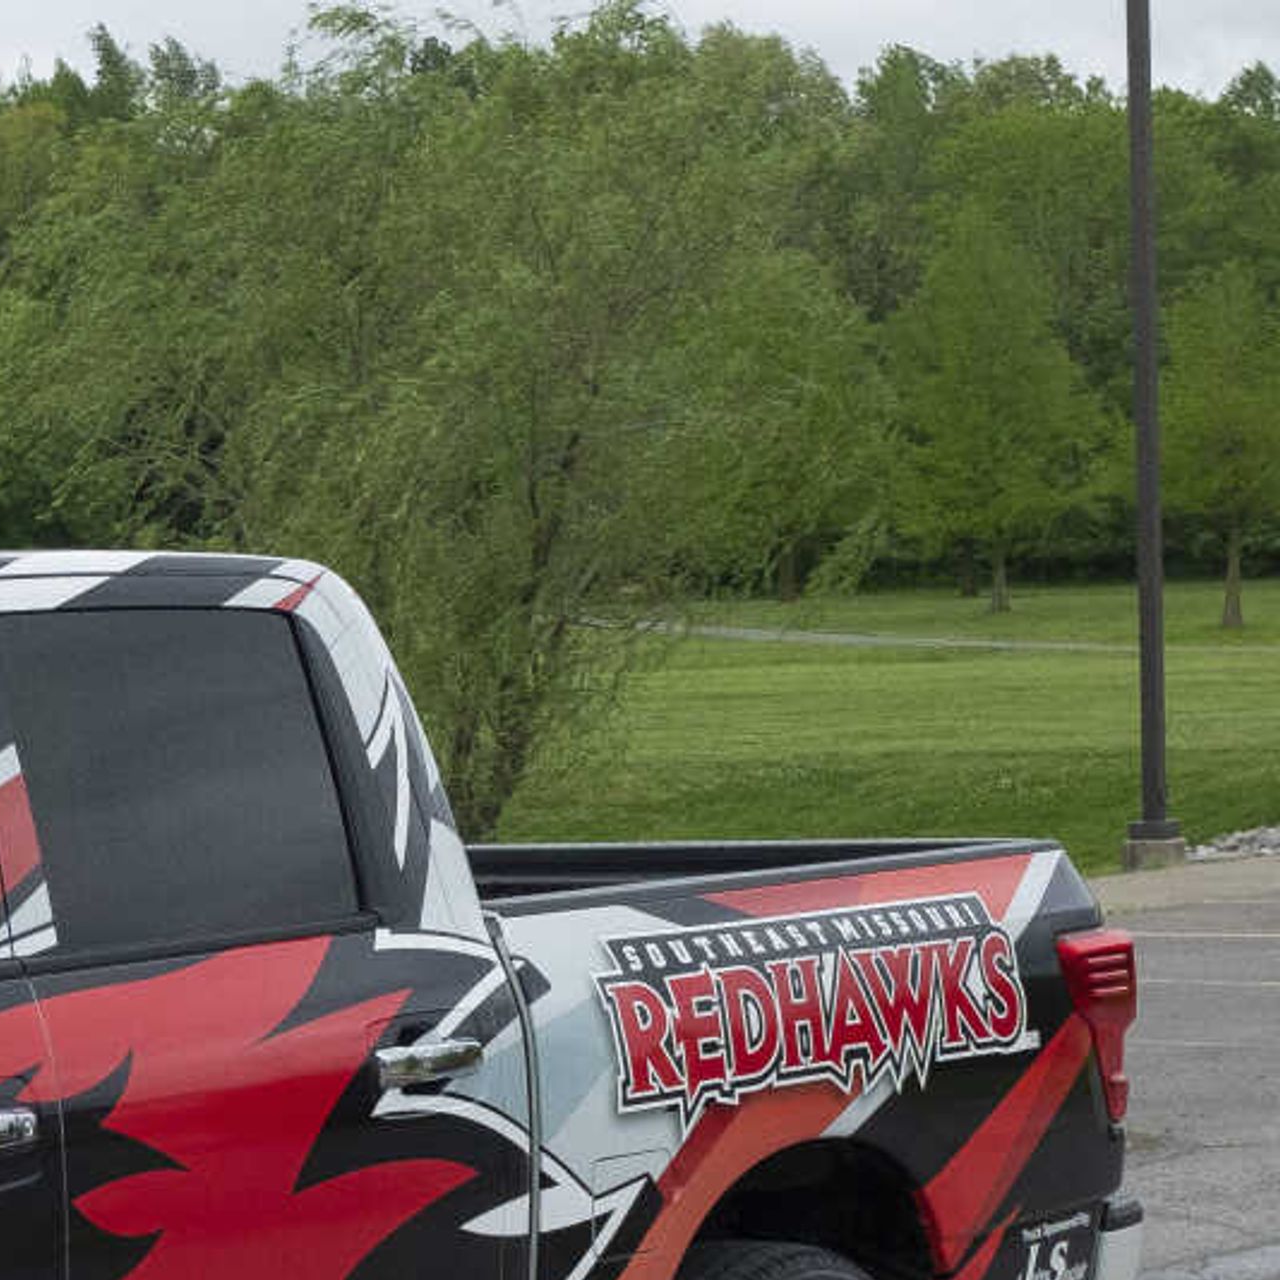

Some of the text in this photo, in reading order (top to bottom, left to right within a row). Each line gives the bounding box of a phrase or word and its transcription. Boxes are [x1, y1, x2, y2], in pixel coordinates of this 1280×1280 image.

[621, 901, 982, 972] SOUTHEAST MISSOURI
[606, 930, 1028, 1105] REDHAWKS
